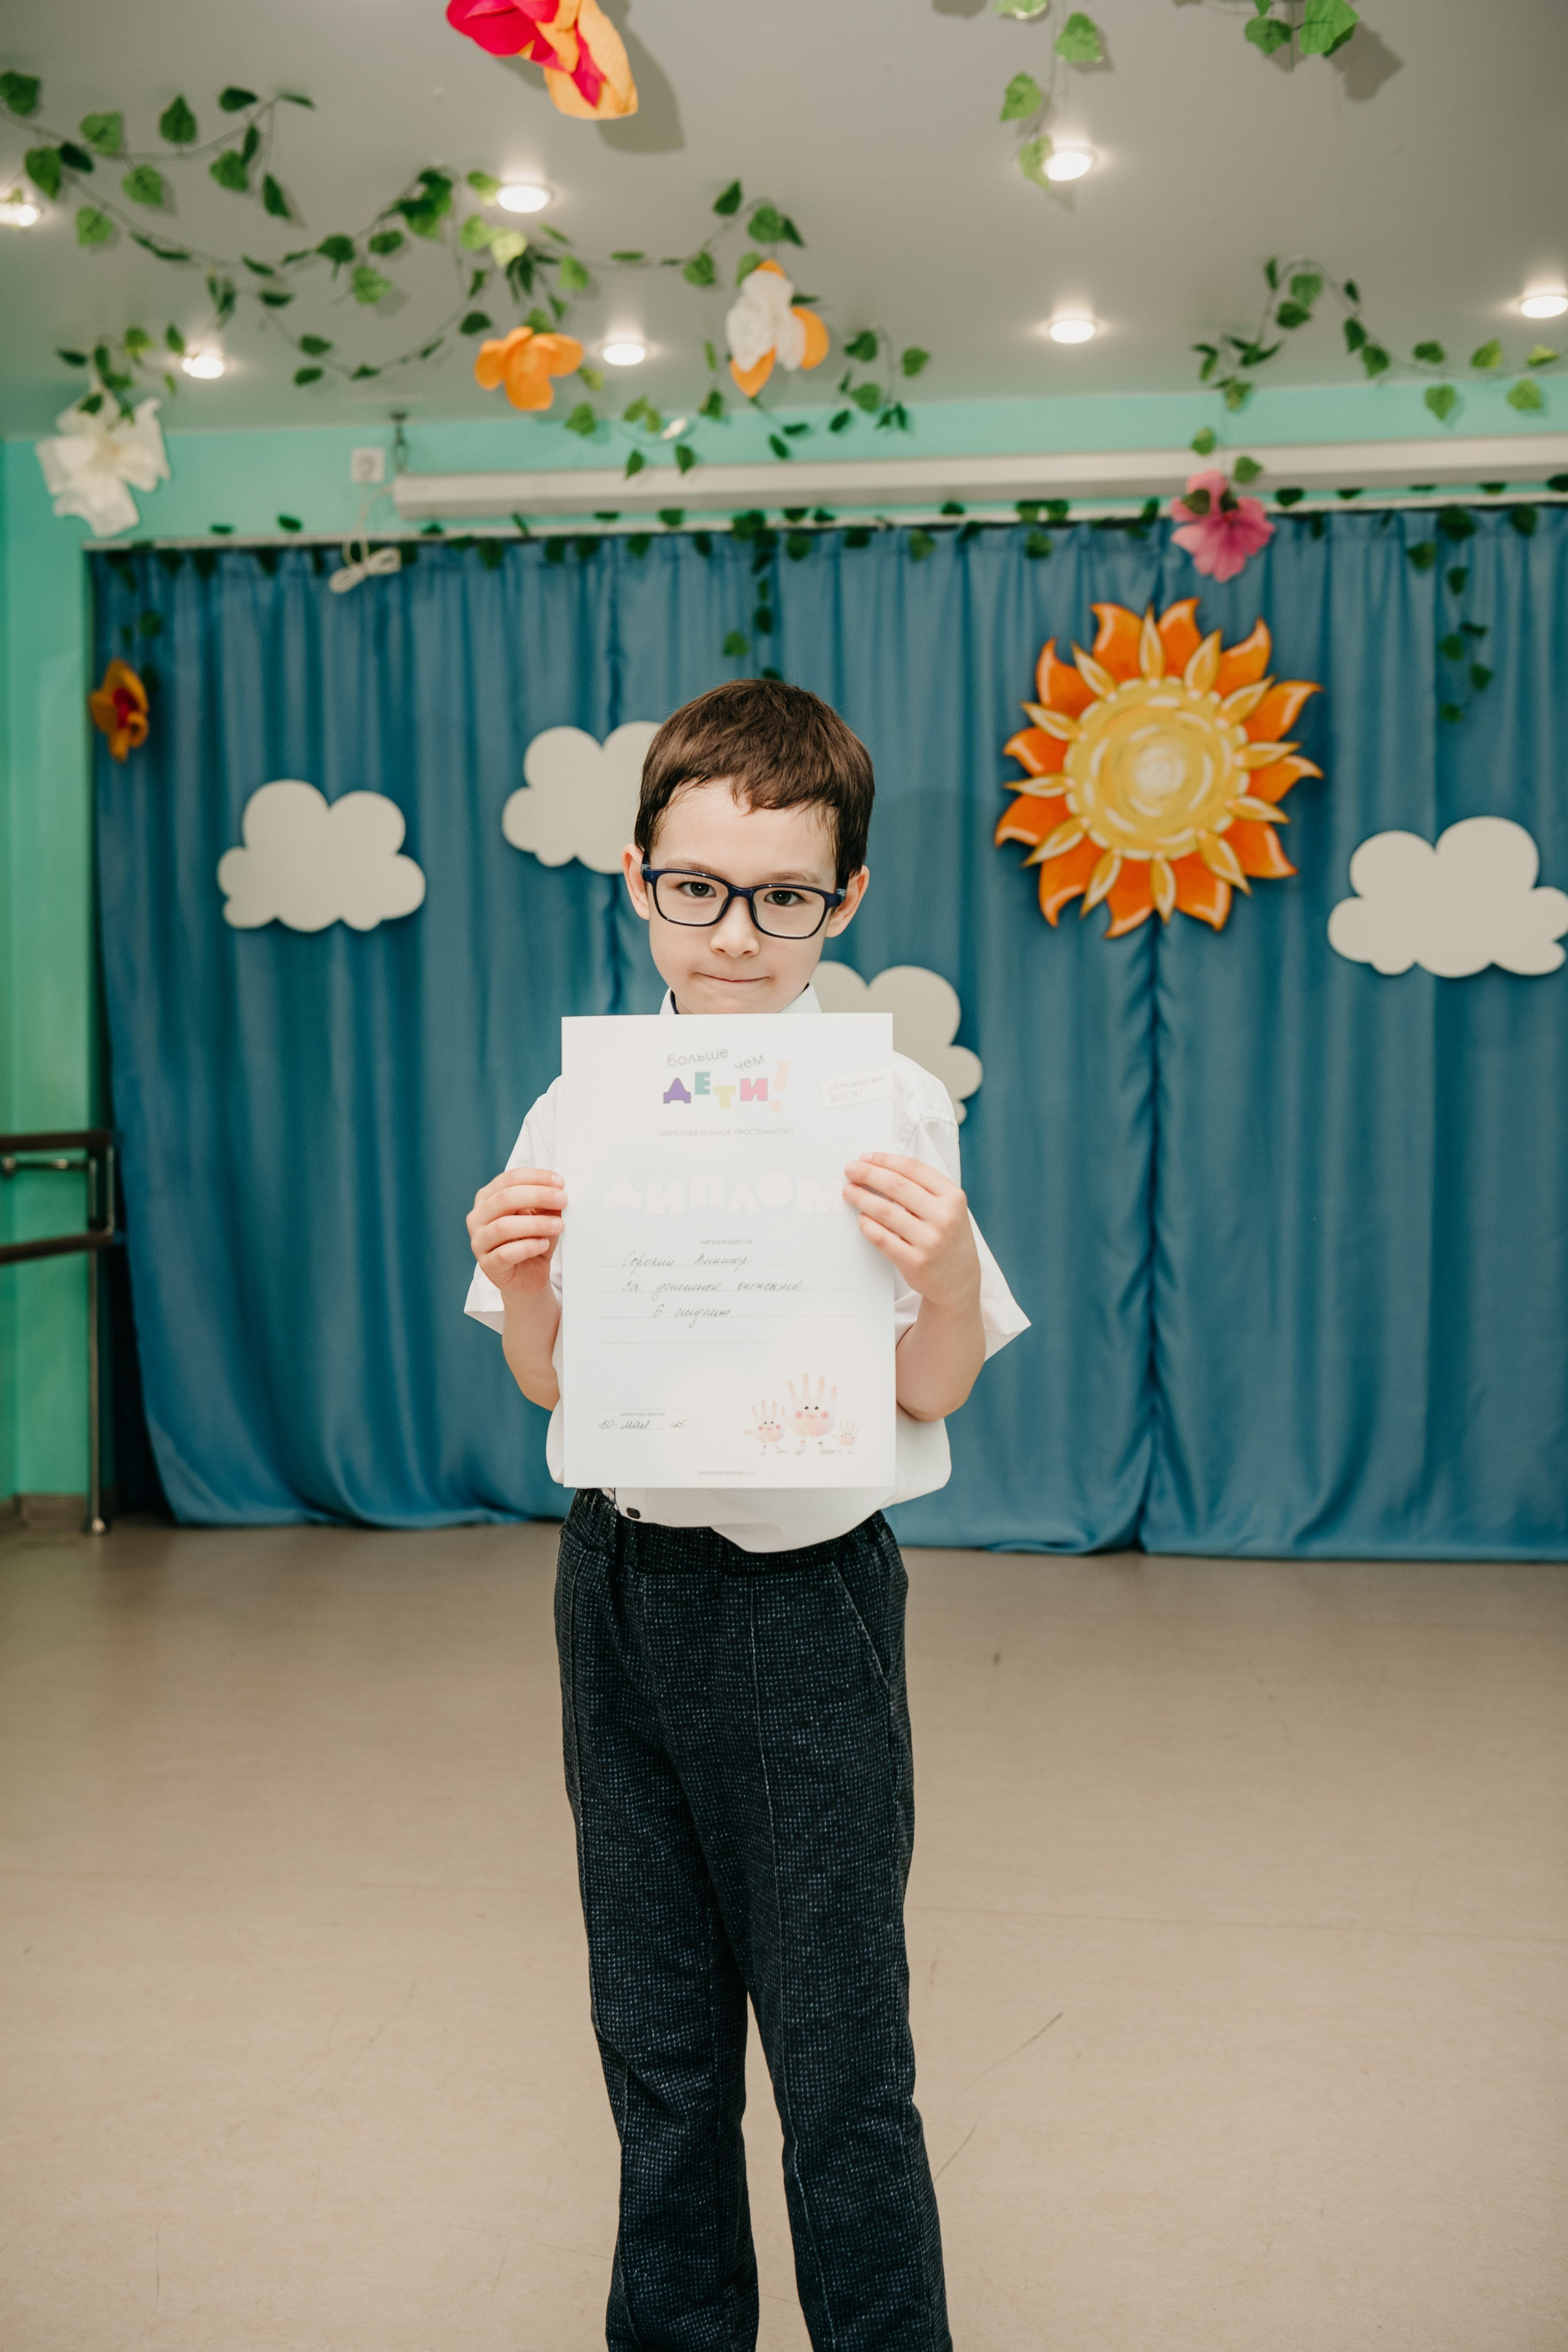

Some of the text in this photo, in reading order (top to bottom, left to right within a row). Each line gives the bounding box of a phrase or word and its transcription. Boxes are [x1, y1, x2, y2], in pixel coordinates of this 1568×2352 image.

[667, 1049, 764, 1070] больше чем
[663, 1061, 790, 1112] ДЕТИ!
[840, 1076, 884, 1090] РОЖДЕНИЯ
[831, 1093, 842, 1102] ДО
[658, 1128, 794, 1137] ОБРАЗОВАТЕЛЬНОЕ ПРОСТРАНСТВО
[604, 1172, 845, 1215] ДИПЛОМ
[622, 1280, 641, 1292] За
